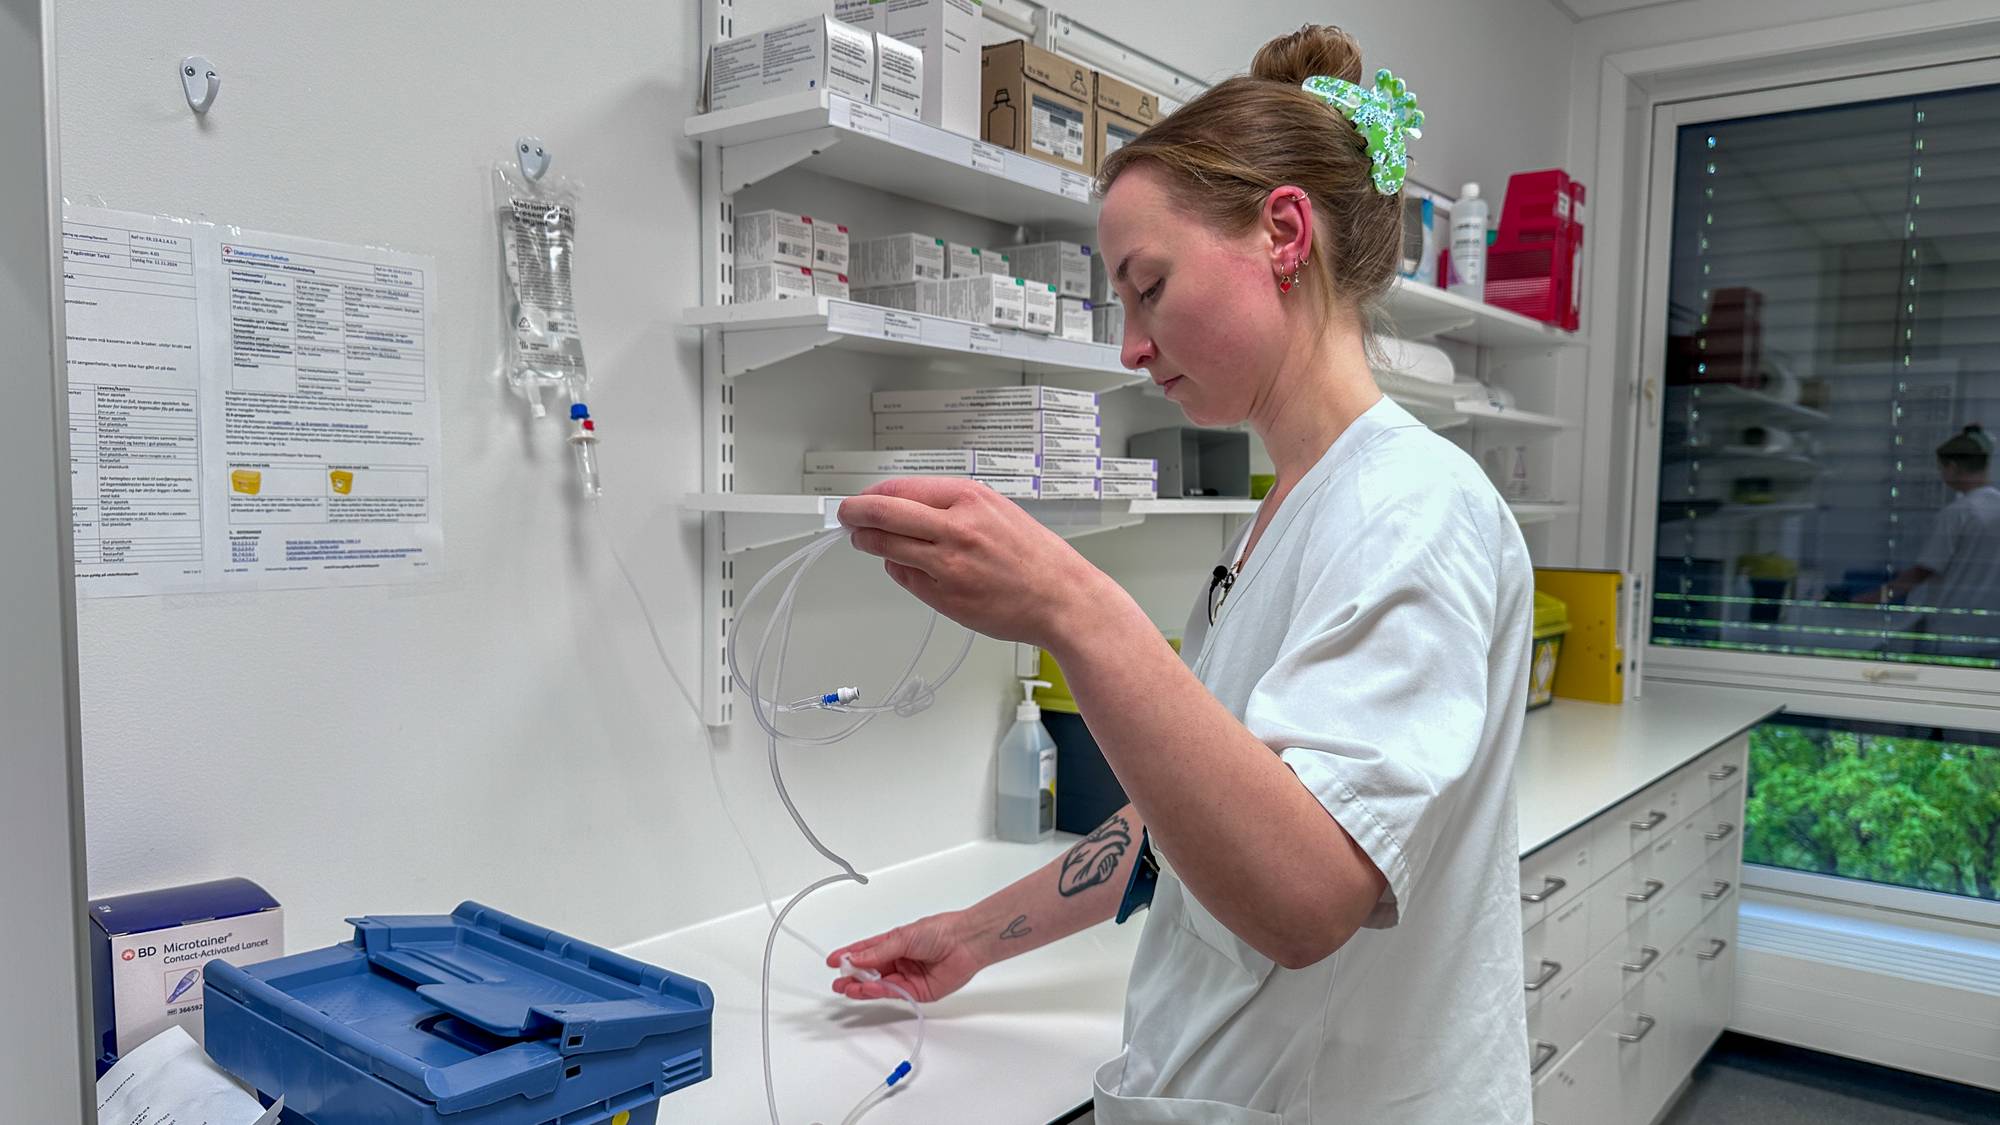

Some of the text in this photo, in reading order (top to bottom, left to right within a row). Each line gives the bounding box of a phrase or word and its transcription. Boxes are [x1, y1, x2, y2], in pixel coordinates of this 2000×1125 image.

[138, 946, 156, 958] BD
[163, 939, 269, 964] Contact-Activated Lancet
